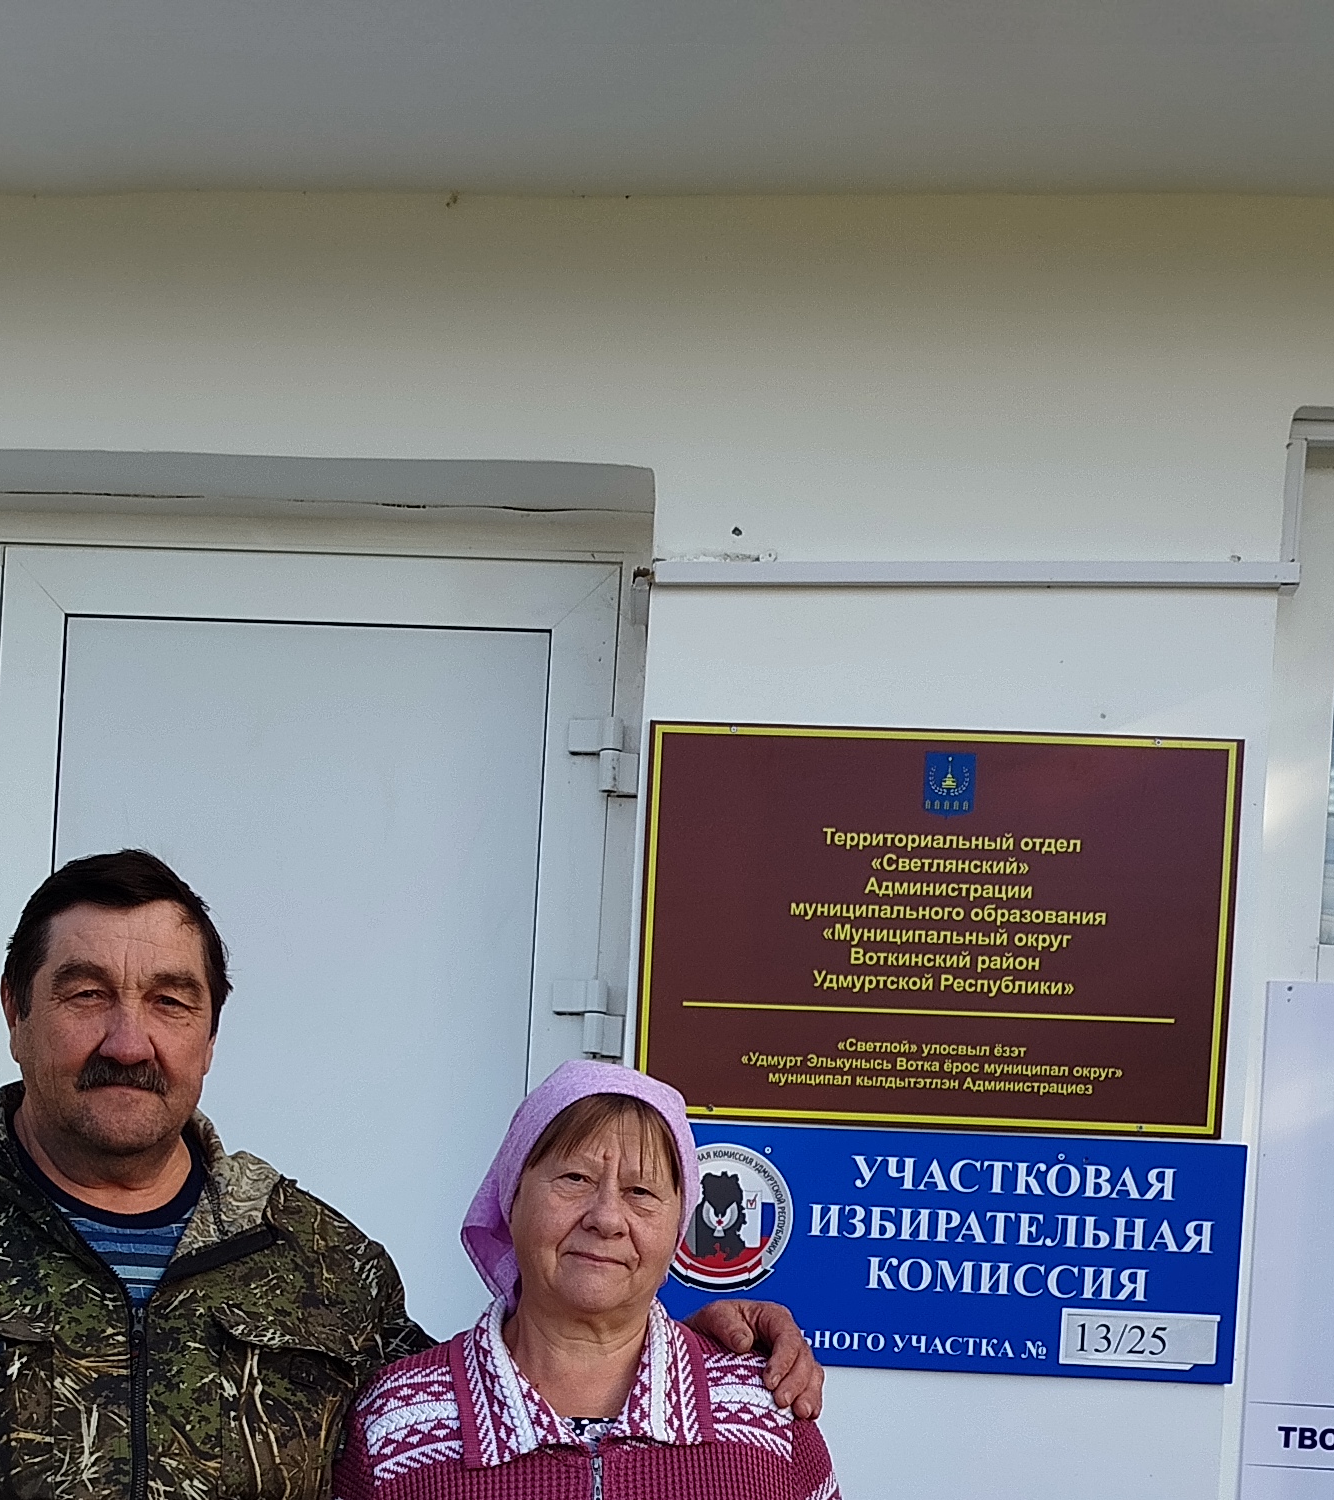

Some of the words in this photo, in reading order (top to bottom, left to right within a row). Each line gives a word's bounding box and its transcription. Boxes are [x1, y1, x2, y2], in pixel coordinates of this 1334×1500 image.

[823, 827, 1014, 852] Территориальный
[1020, 837, 1081, 855] отдел
[871, 853, 1029, 875] «Светлянский»
[864, 877, 1033, 902] Администрации
[790, 902, 965, 921] муниципального
[970, 904, 1107, 926] образования
[823, 923, 1008, 946] «Муниципальный
[1014, 933, 1072, 952] округ
[850, 947, 971, 968] Воткинский
[977, 953, 1040, 973] район
[813, 970, 934, 993] Удмуртской
[940, 974, 1075, 997] Республики»
[837, 1038, 918, 1053] «Светлой»
[922, 1044, 990, 1057] улосвыл
[993, 1044, 1027, 1057] ёзэт
[741, 1052, 804, 1069] «Удмурт
[807, 1054, 892, 1072] Элькунысь
[896, 1057, 940, 1072] Вотка
[943, 1062, 980, 1075] ёрос
[983, 1063, 1069, 1077] муниципал
[1072, 1067, 1123, 1081] округ»
[768, 1073, 852, 1086] муниципал
[855, 1076, 959, 1090] кылдытэтлэн
[962, 1077, 1093, 1096] Администрациез
[713, 1149, 755, 1166] КОМИССИЯ
[753, 1160, 786, 1204] УДМУРТСКОЙ
[852, 1155, 1175, 1201] УЧАСТКОВАЯ
[766, 1206, 787, 1256] РЕСПУБЛИКИ
[810, 1204, 1213, 1254] ИЗБИРАТЕЛЬНАЯ
[867, 1257, 1148, 1301] КОМИССИЯ
[893, 1334, 1014, 1358] УЧАСТКА
[1021, 1341, 1047, 1359] №
[1076, 1322, 1168, 1356] 13/25
